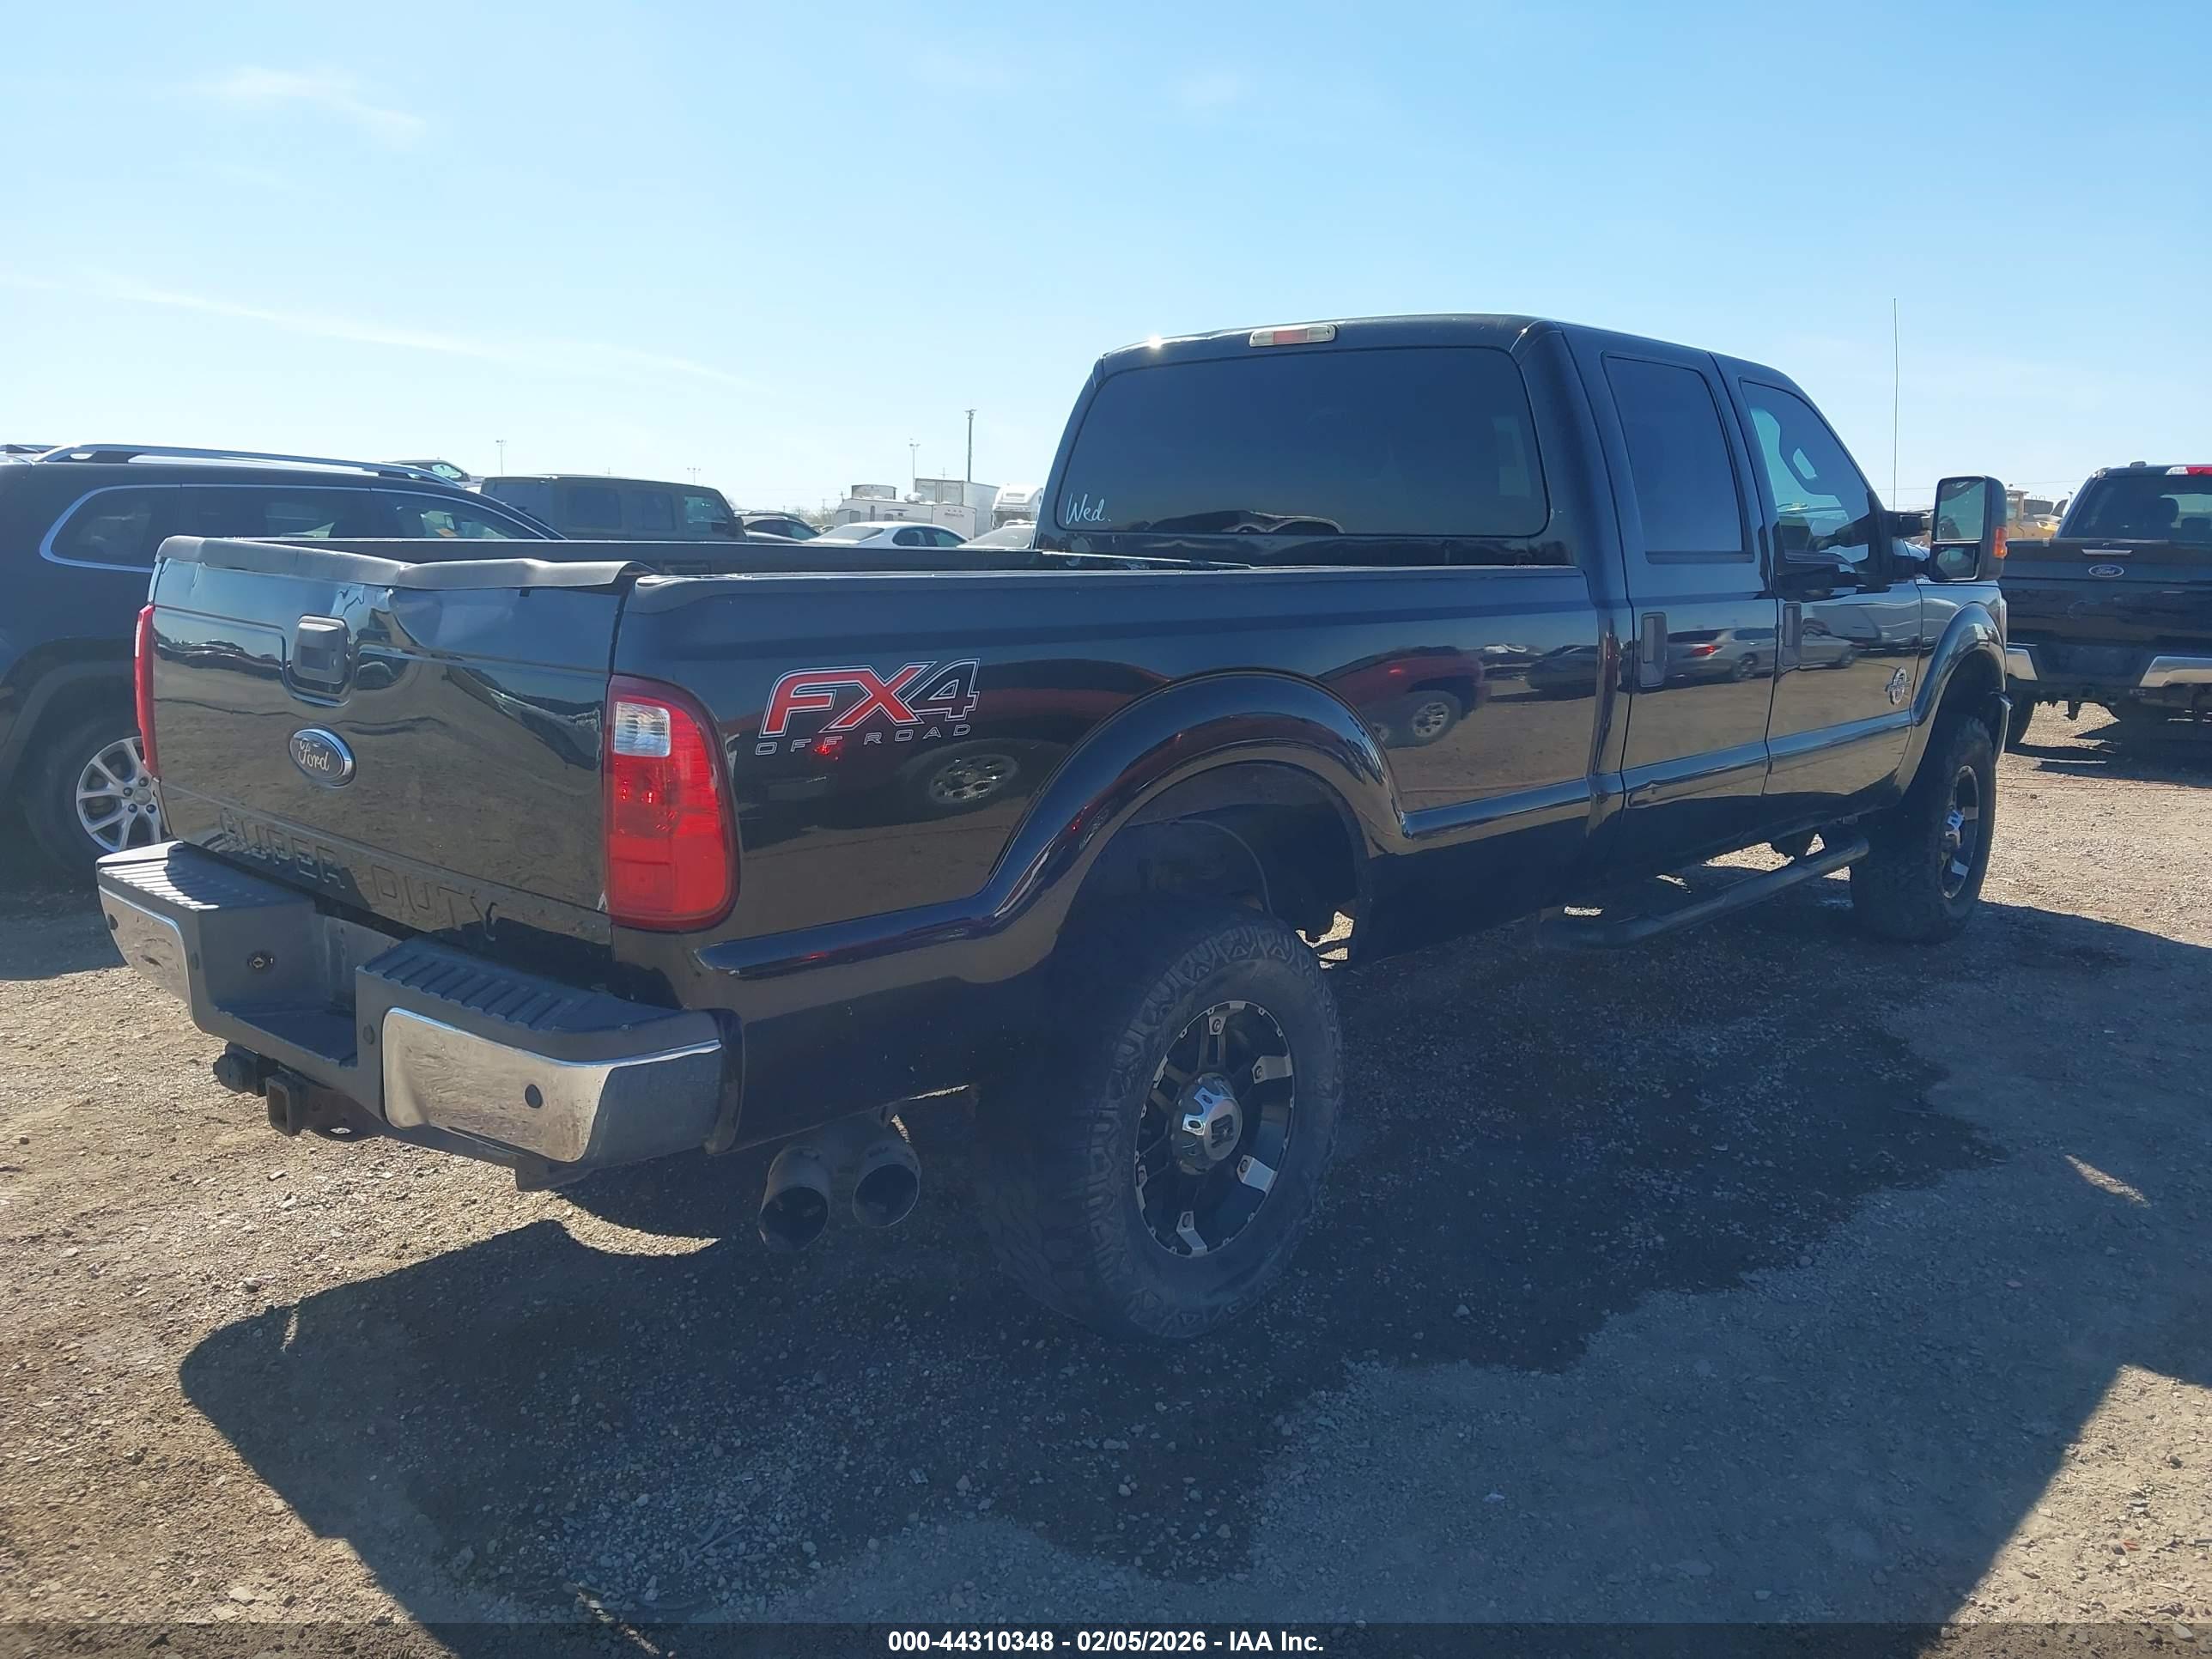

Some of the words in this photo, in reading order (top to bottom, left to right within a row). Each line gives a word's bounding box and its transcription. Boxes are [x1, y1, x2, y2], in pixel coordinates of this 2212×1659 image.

[758, 658, 981, 738] FX4
[297, 737, 331, 772] Ford
[755, 736, 843, 756] OFF
[863, 725, 972, 745] ROAD
[370, 863, 500, 942] DUTY
